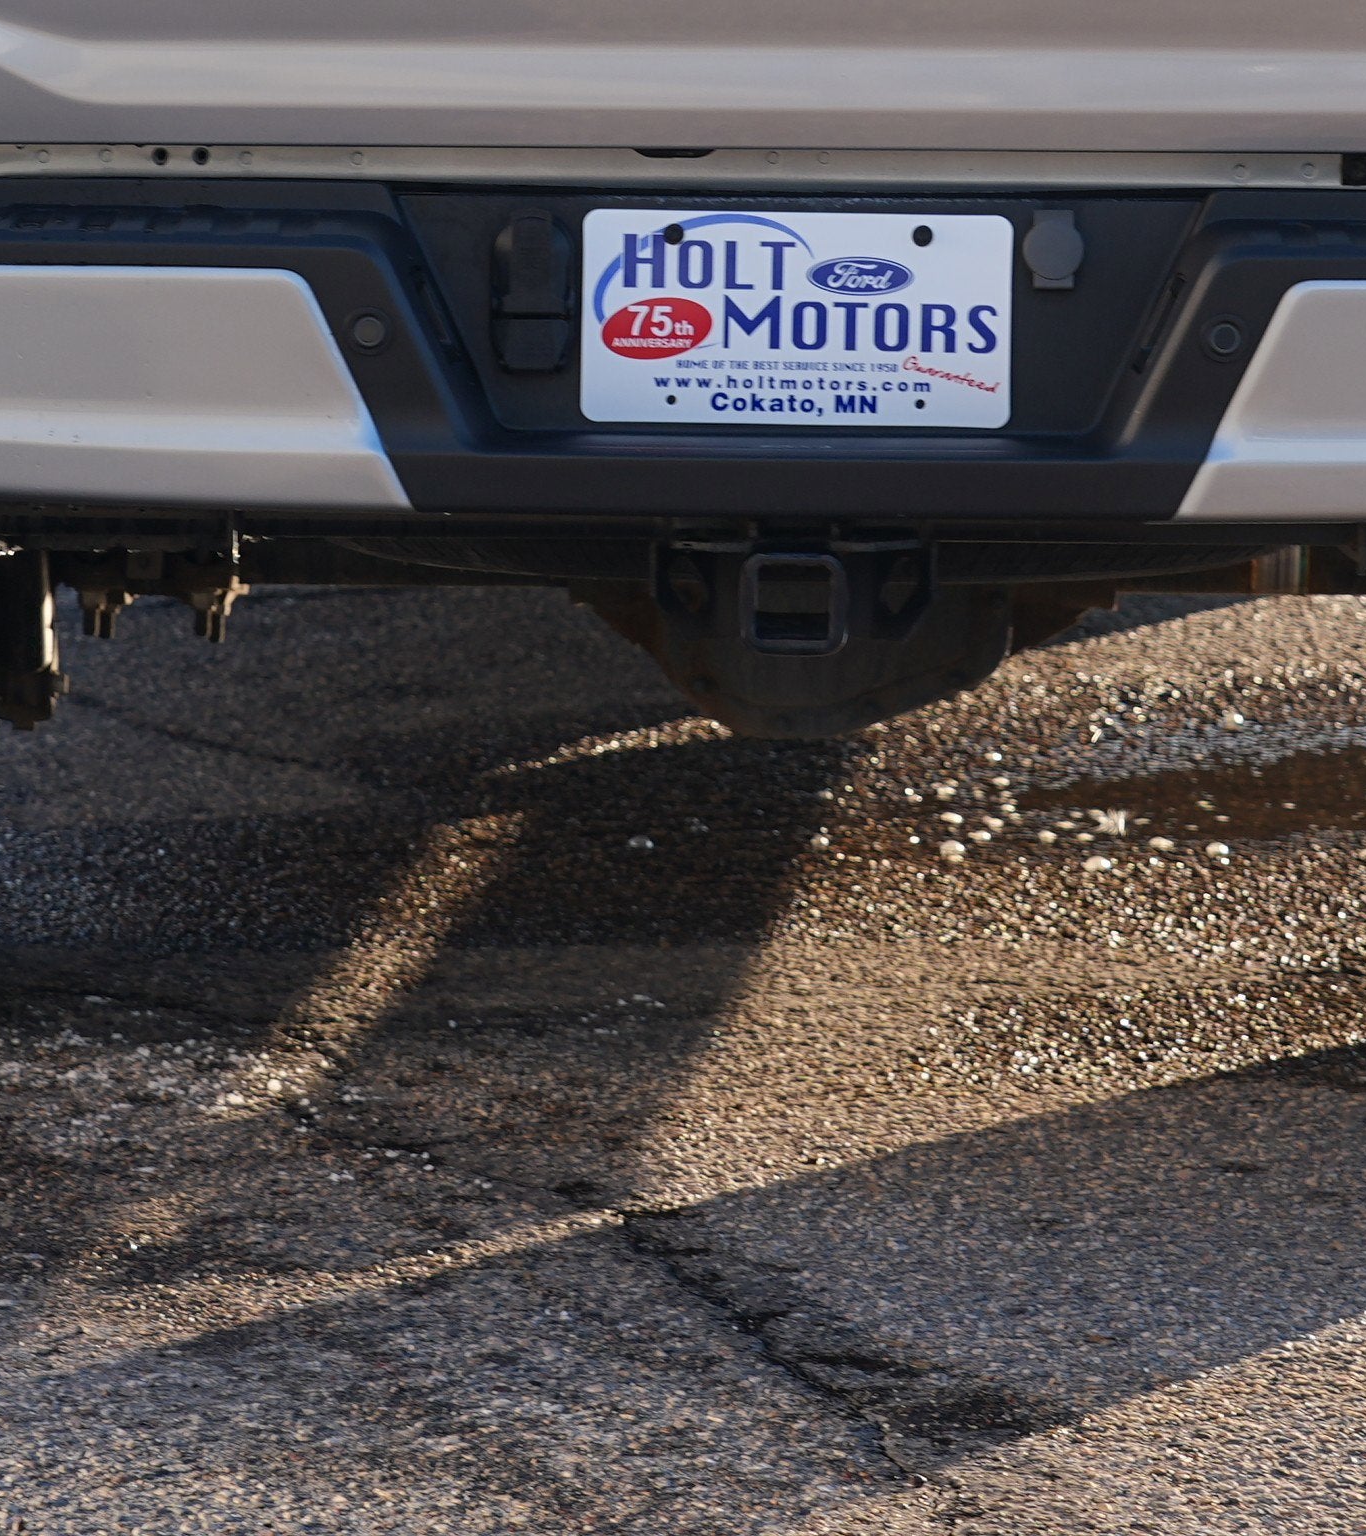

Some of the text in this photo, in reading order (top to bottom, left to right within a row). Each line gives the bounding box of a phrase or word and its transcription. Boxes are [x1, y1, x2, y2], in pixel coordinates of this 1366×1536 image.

[623, 233, 795, 290] HOLT
[828, 261, 894, 290] Ford
[627, 305, 695, 337] 75th
[724, 295, 997, 354] MOTORS
[611, 337, 694, 349] ANNIVERSARY
[676, 360, 708, 369] HOME
[712, 360, 726, 369] OF
[730, 360, 749, 370] THE
[753, 361, 779, 370] BEST
[783, 362, 829, 371] SERVICE
[833, 362, 866, 372] SINCE
[903, 356, 1001, 393] Guaranteed
[654, 374, 932, 392] www.holtmotors.com
[711, 392, 877, 417] Cokato, MN
